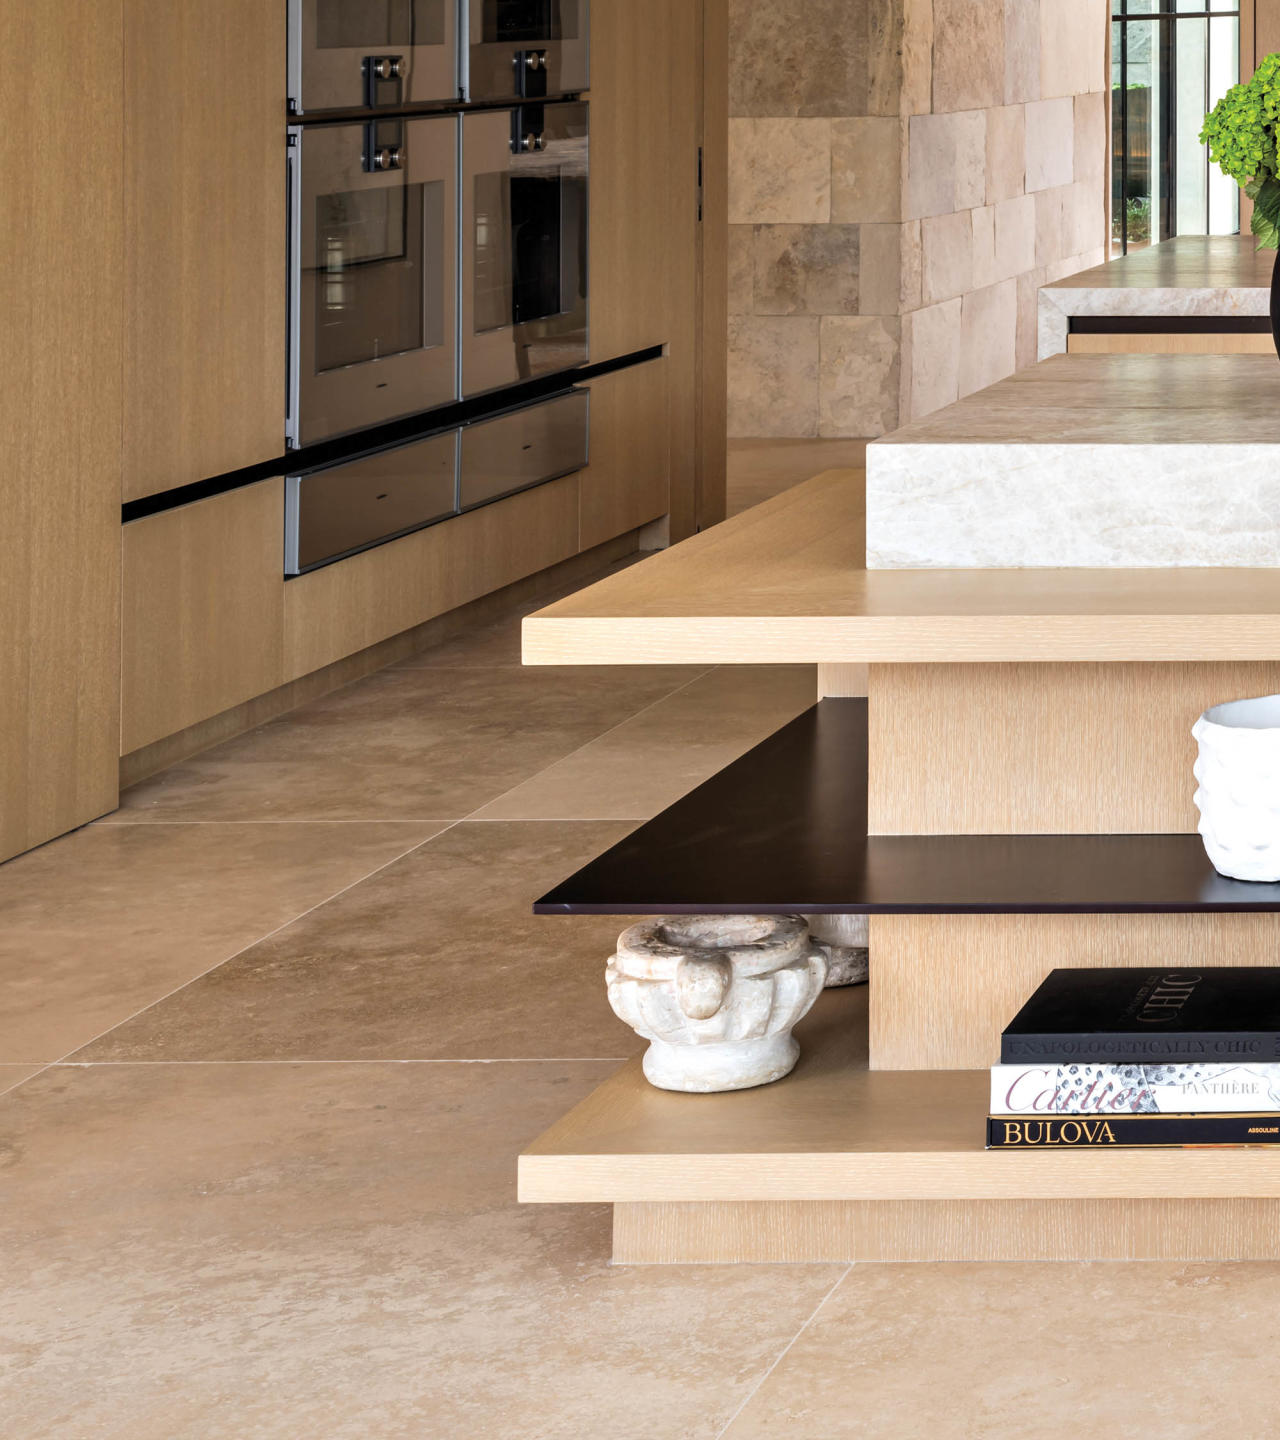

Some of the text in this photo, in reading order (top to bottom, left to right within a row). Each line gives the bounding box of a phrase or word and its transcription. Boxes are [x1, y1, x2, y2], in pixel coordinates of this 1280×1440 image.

[1136, 973, 1203, 1023] CHIC
[1008, 1039, 1210, 1057] UNAPOLOGETICALLY
[1215, 1038, 1262, 1054] CHIC
[1004, 1068, 1156, 1112] Cartier
[1182, 1079, 1260, 1096] PANTHÈRE
[1003, 1121, 1117, 1144] BULOVA
